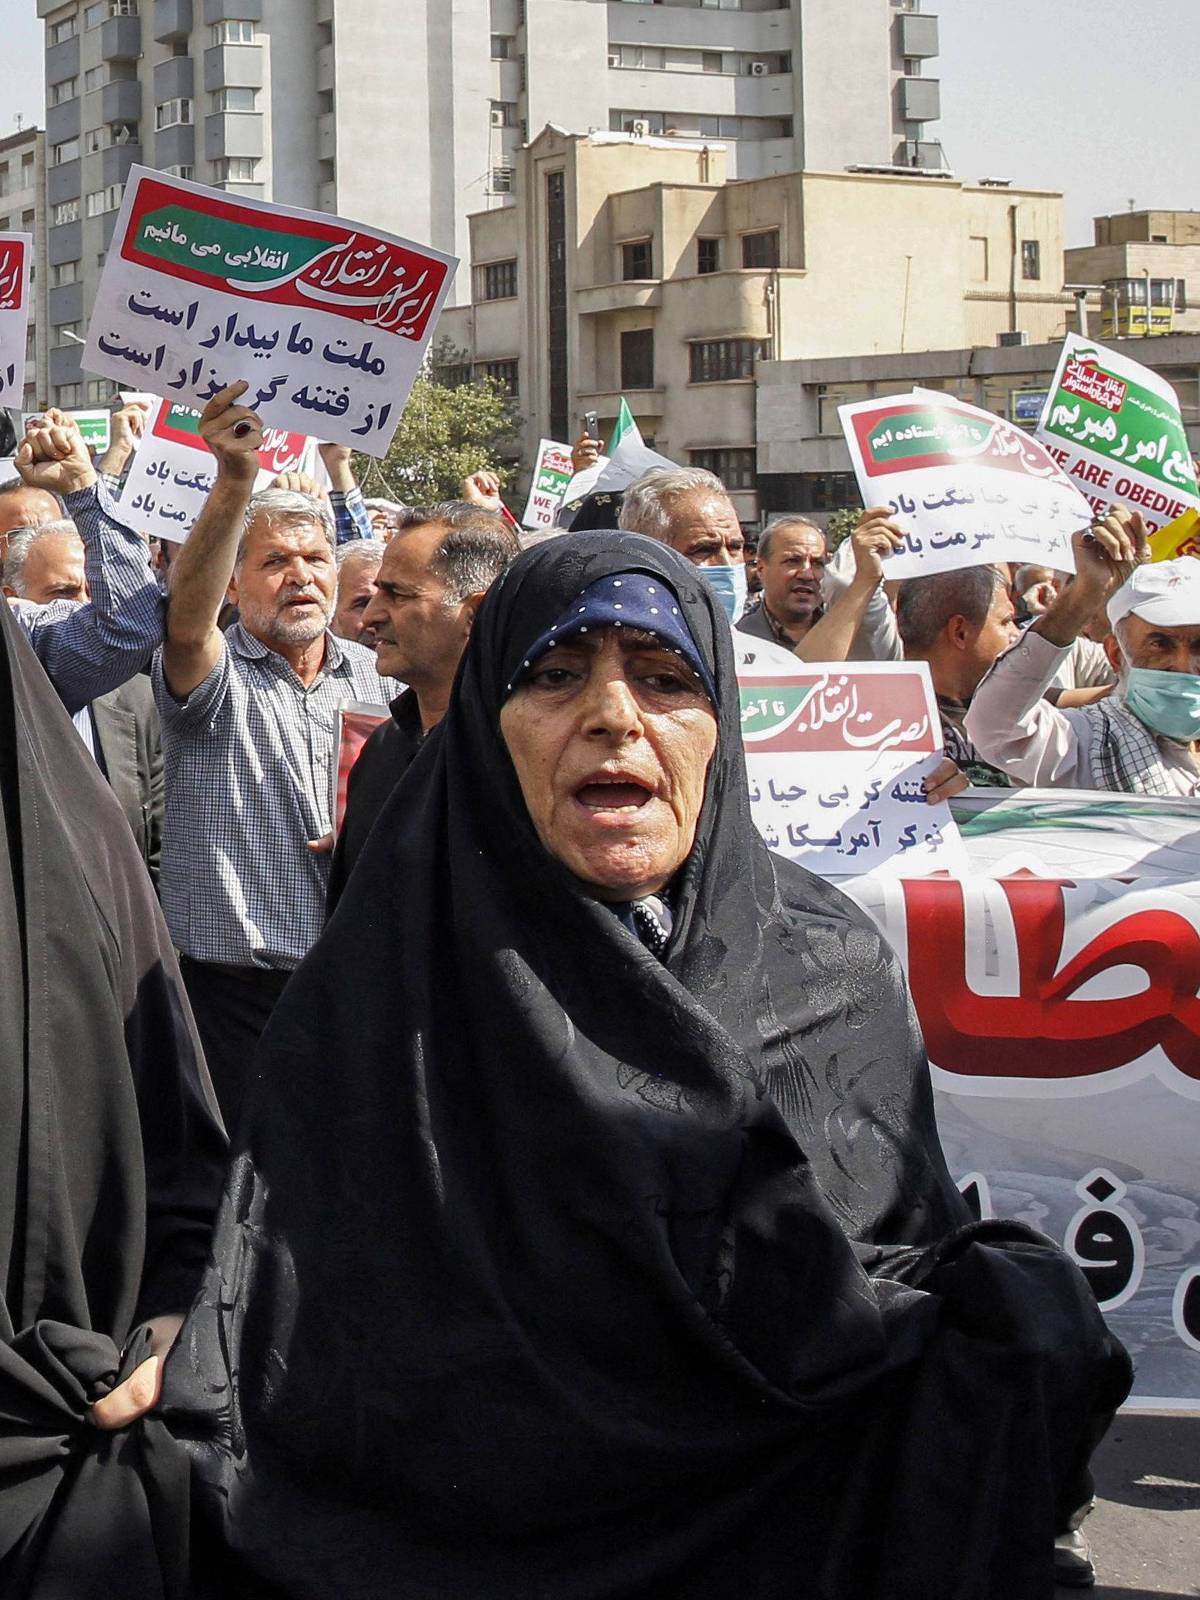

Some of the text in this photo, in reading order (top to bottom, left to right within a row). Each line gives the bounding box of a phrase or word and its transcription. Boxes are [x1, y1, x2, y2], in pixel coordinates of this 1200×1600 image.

[143, 221, 289, 271] انقلابی می مانیم
[128, 290, 386, 376] ملت ما بیدار است
[97, 332, 166, 371] است
[291, 385, 350, 417] فتنه
[350, 403, 392, 436] از
[146, 461, 170, 485] باد
[533, 496, 552, 509] WE
[1070, 459, 1113, 488] ARE
[1115, 478, 1190, 519] OBEDIE
[131, 493, 155, 518] باد
[537, 512, 551, 524] TO
[768, 778, 808, 808] حیا
[818, 784, 850, 808] بی
